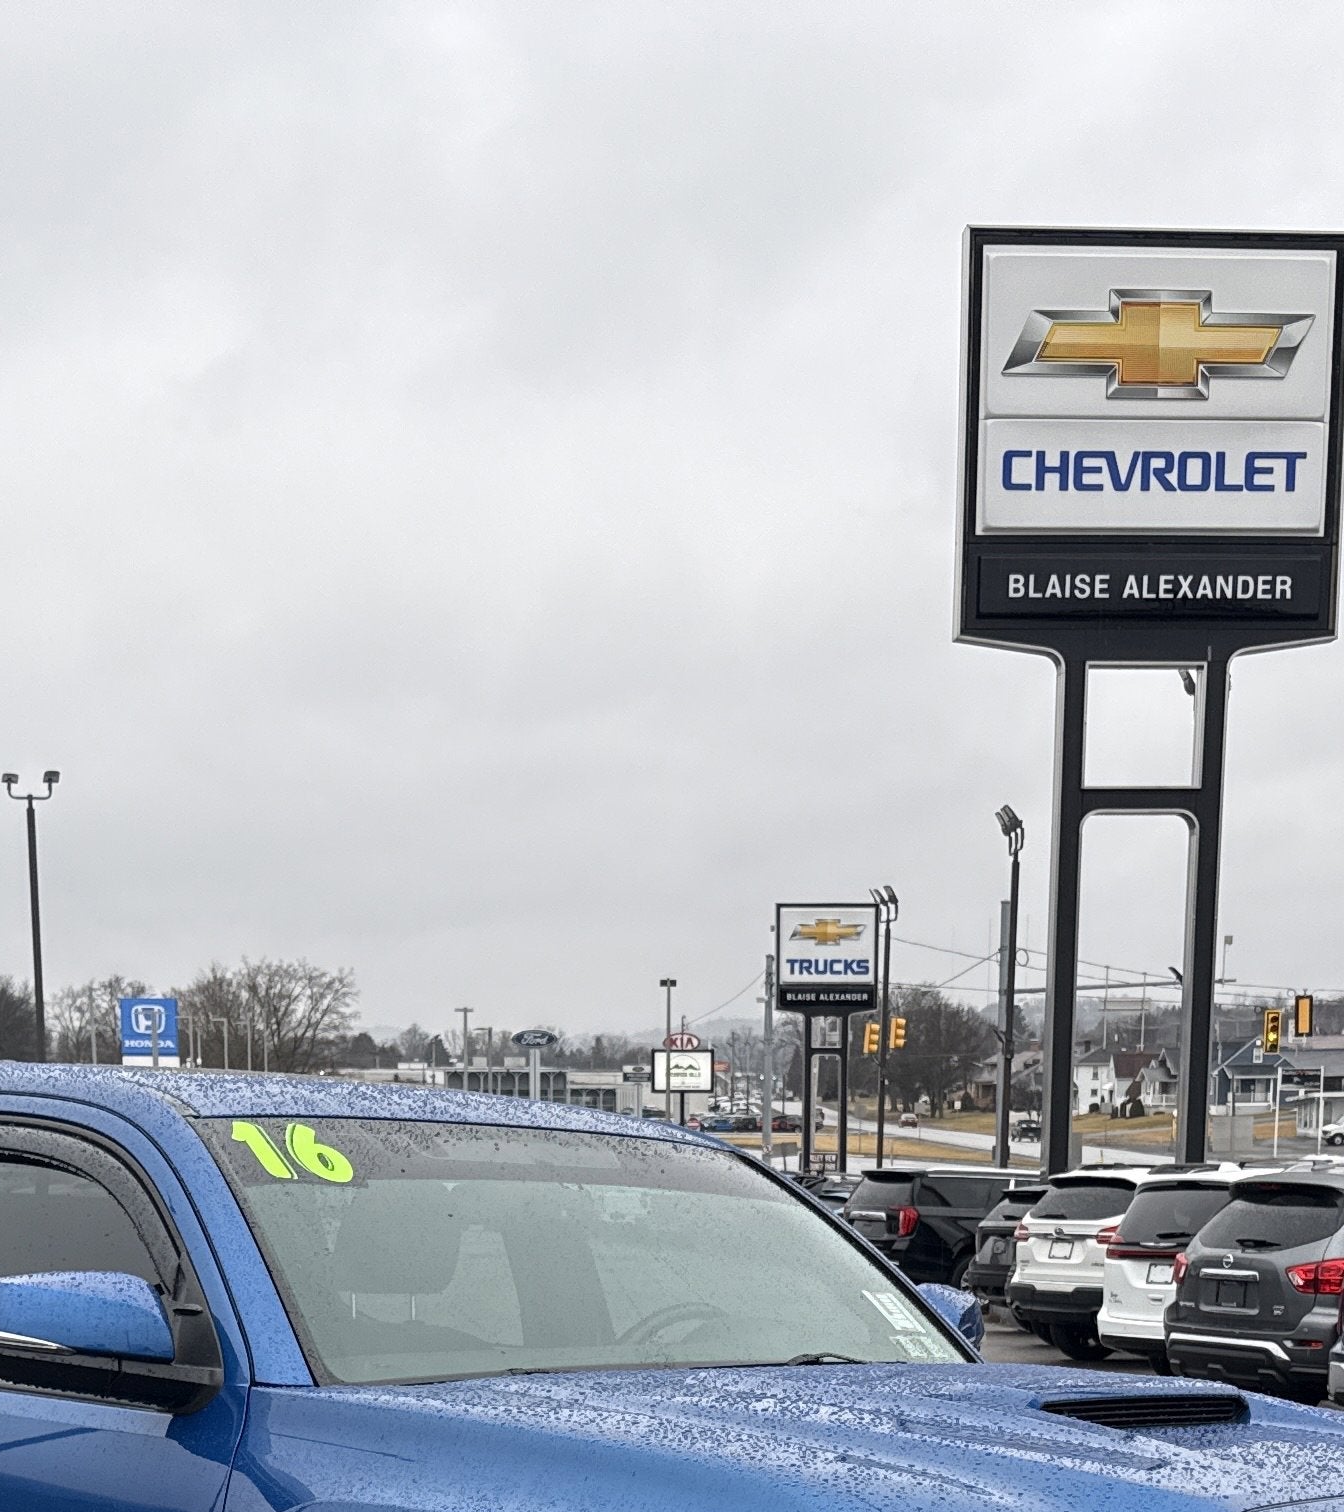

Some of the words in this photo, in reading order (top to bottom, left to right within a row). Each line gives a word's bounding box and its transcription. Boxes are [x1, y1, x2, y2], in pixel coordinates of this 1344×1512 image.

[1002, 449, 1308, 493] CHEVROLET
[1007, 573, 1111, 600] BLAISE
[1122, 574, 1293, 601] ALEXANDER
[785, 958, 870, 976] TRUCKS
[786, 992, 816, 1002] BLAISE
[819, 992, 869, 1002] ALEXANDER
[520, 1032, 549, 1046] Ford
[232, 1121, 354, 1183] 16
